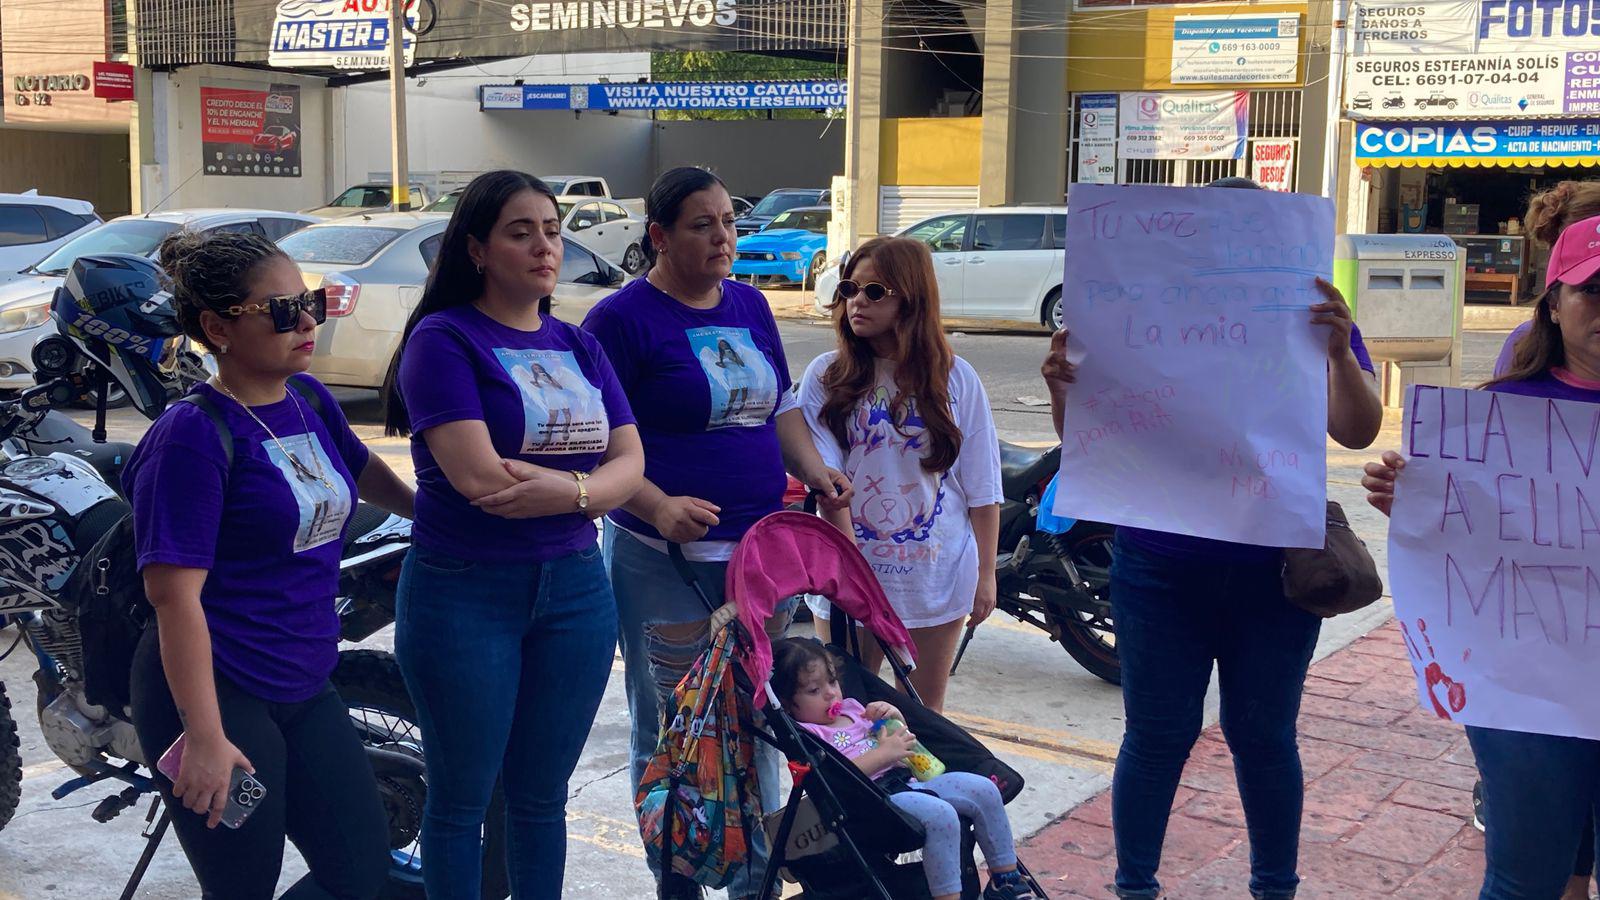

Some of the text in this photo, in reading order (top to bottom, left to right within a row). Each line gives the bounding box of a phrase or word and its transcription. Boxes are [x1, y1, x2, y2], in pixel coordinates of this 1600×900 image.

[510, 0, 737, 32] SEMINUEVOS
[1358, 6, 1426, 17] SEGUROS
[1361, 18, 1422, 29] DAÑOS A
[277, 22, 371, 50] MASTER
[1354, 30, 1428, 41] TERCEROS
[1222, 42, 1281, 51] 669 163 0009
[1356, 55, 1559, 73] SEGUROS ESTEFANNÍA SOLÍS
[14, 74, 90, 92] NOTARIO
[1179, 73, 1290, 81] www.suitesmardecortes.com
[1372, 72, 1540, 86] CEL: 6691-07-04-04
[604, 86, 659, 97] VISITA
[665, 85, 748, 97] NUESTRO
[235, 101, 256, 109] DESDE
[256, 102, 263, 110] EL
[608, 96, 848, 108] WWW.AUTOMASTERSEMINU
[1162, 98, 1219, 115] Quálitas
[206, 108, 264, 119] 10% DE ENGANCHE
[212, 118, 220, 126] EL
[229, 119, 259, 128] MENSUAL
[1359, 126, 1498, 154] COPIAS
[1529, 141, 1540, 153] DE
[1541, 140, 1592, 152] NACIMIENTO
[1255, 144, 1291, 161] SEGUROS
[1260, 166, 1285, 182] DESDE
[1404, 250, 1455, 260] EXPRESSO
[73, 312, 151, 354] 100%
[1409, 384, 1514, 468] ELLA
[1440, 472, 1600, 551] A ELLA
[871, 563, 914, 575] STINY
